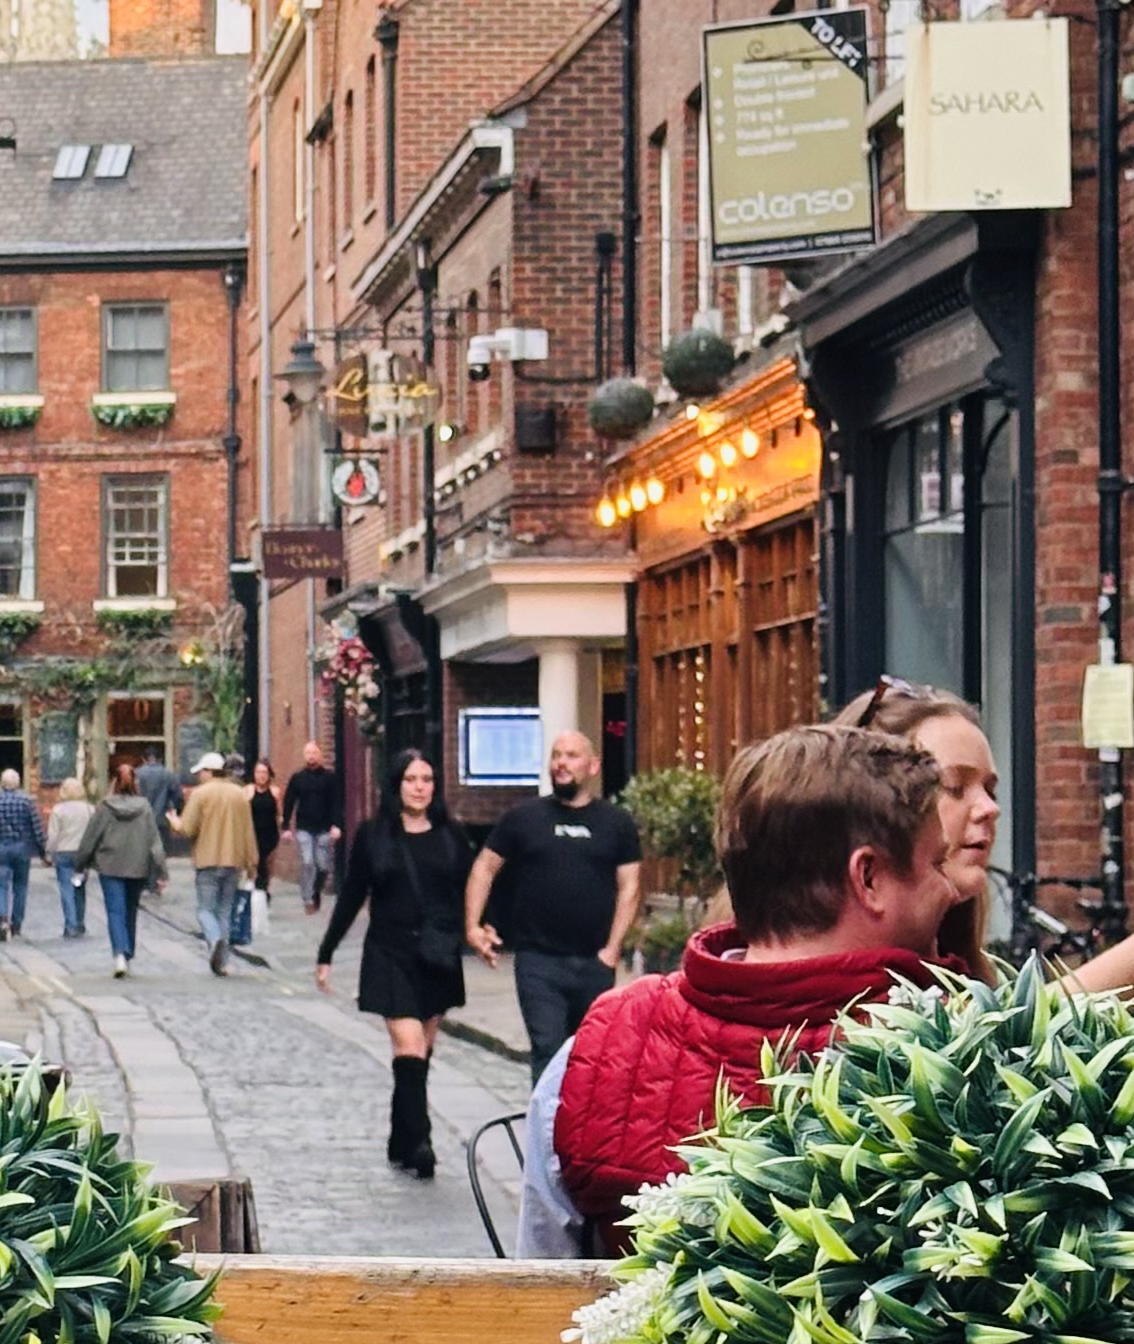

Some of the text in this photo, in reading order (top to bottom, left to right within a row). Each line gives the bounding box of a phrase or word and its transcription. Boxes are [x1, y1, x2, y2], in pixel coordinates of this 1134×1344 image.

[811, 16, 836, 45] TO
[928, 89, 1044, 116] SAHARA
[718, 187, 855, 225] colenso
